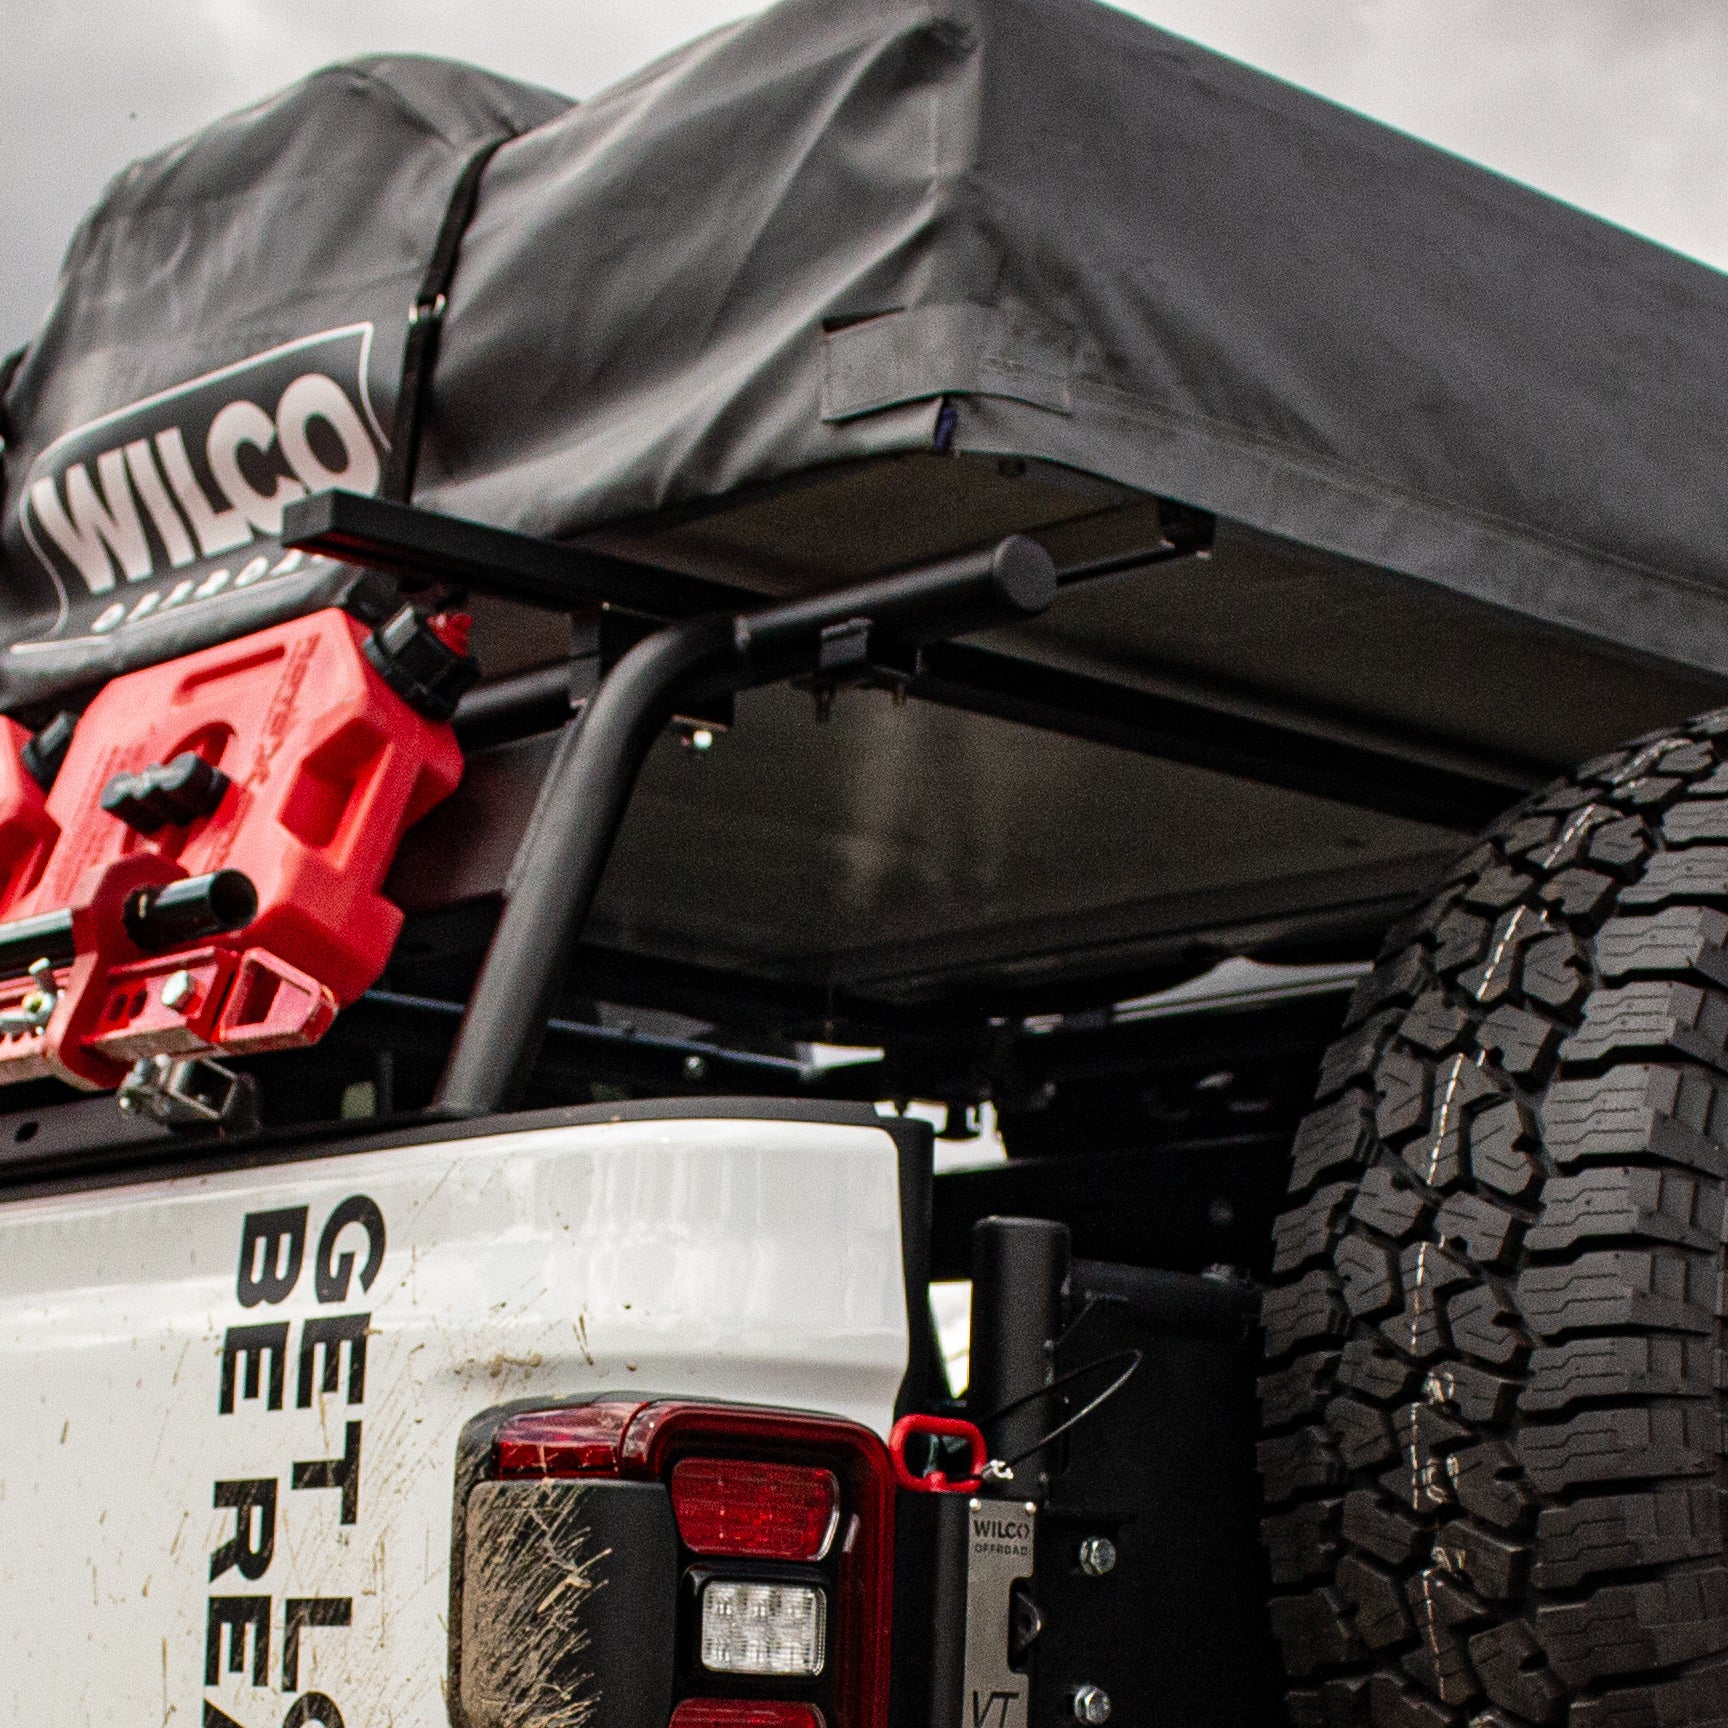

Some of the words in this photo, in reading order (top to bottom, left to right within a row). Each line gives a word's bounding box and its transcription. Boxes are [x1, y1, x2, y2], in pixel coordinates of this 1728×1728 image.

[30, 373, 380, 596] WILCO
[218, 1205, 309, 1415] BE
[291, 1194, 387, 1525] GET
[974, 1519, 1030, 1539] WILCO
[975, 1543, 1029, 1556] OFFROAD
